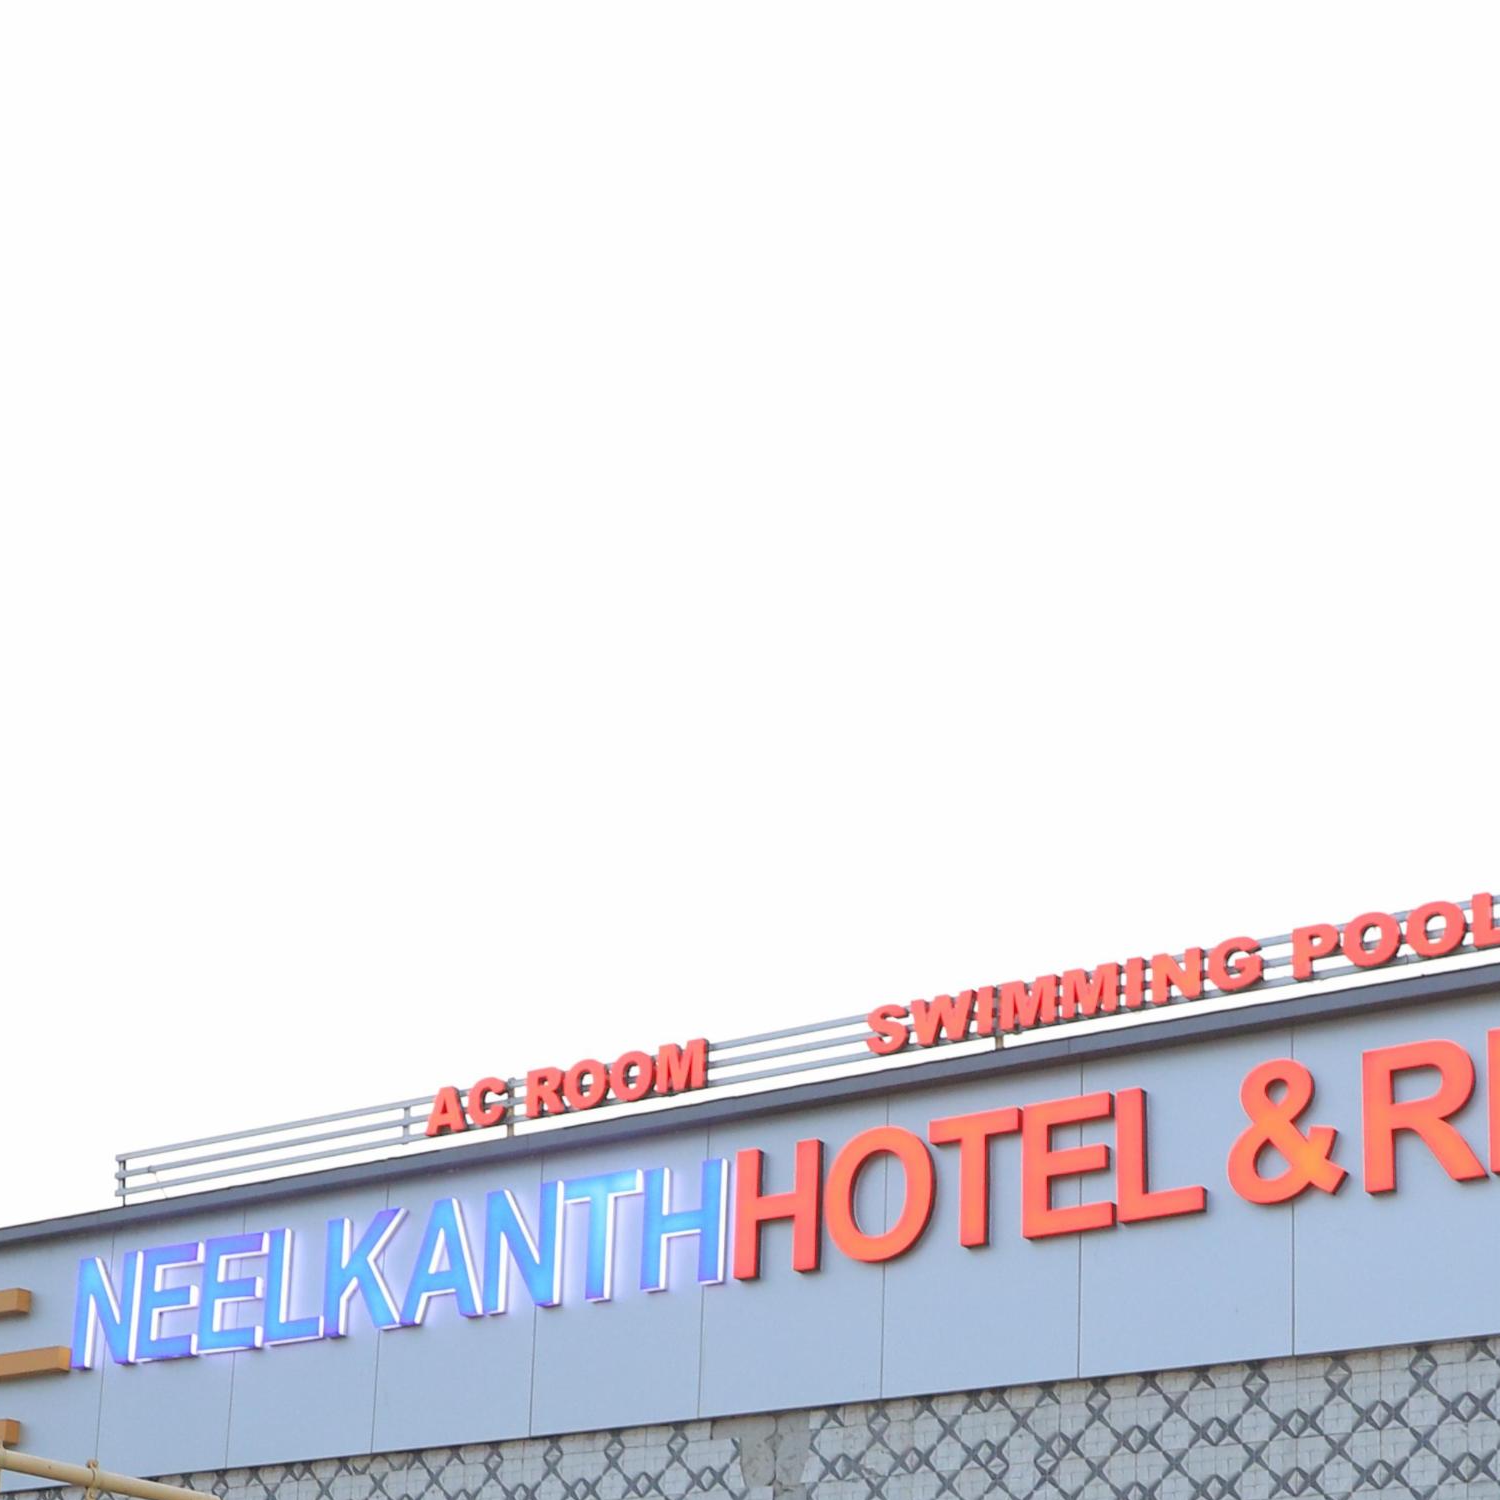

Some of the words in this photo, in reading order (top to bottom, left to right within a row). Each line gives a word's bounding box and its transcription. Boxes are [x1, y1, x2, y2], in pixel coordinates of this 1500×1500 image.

[866, 935, 1264, 1056] SWIMMING
[426, 1077, 508, 1137] AC
[524, 1038, 708, 1120] ROOM
[70, 1157, 730, 1370] NEELKANTH
[732, 1087, 1207, 1281] HOTEL
